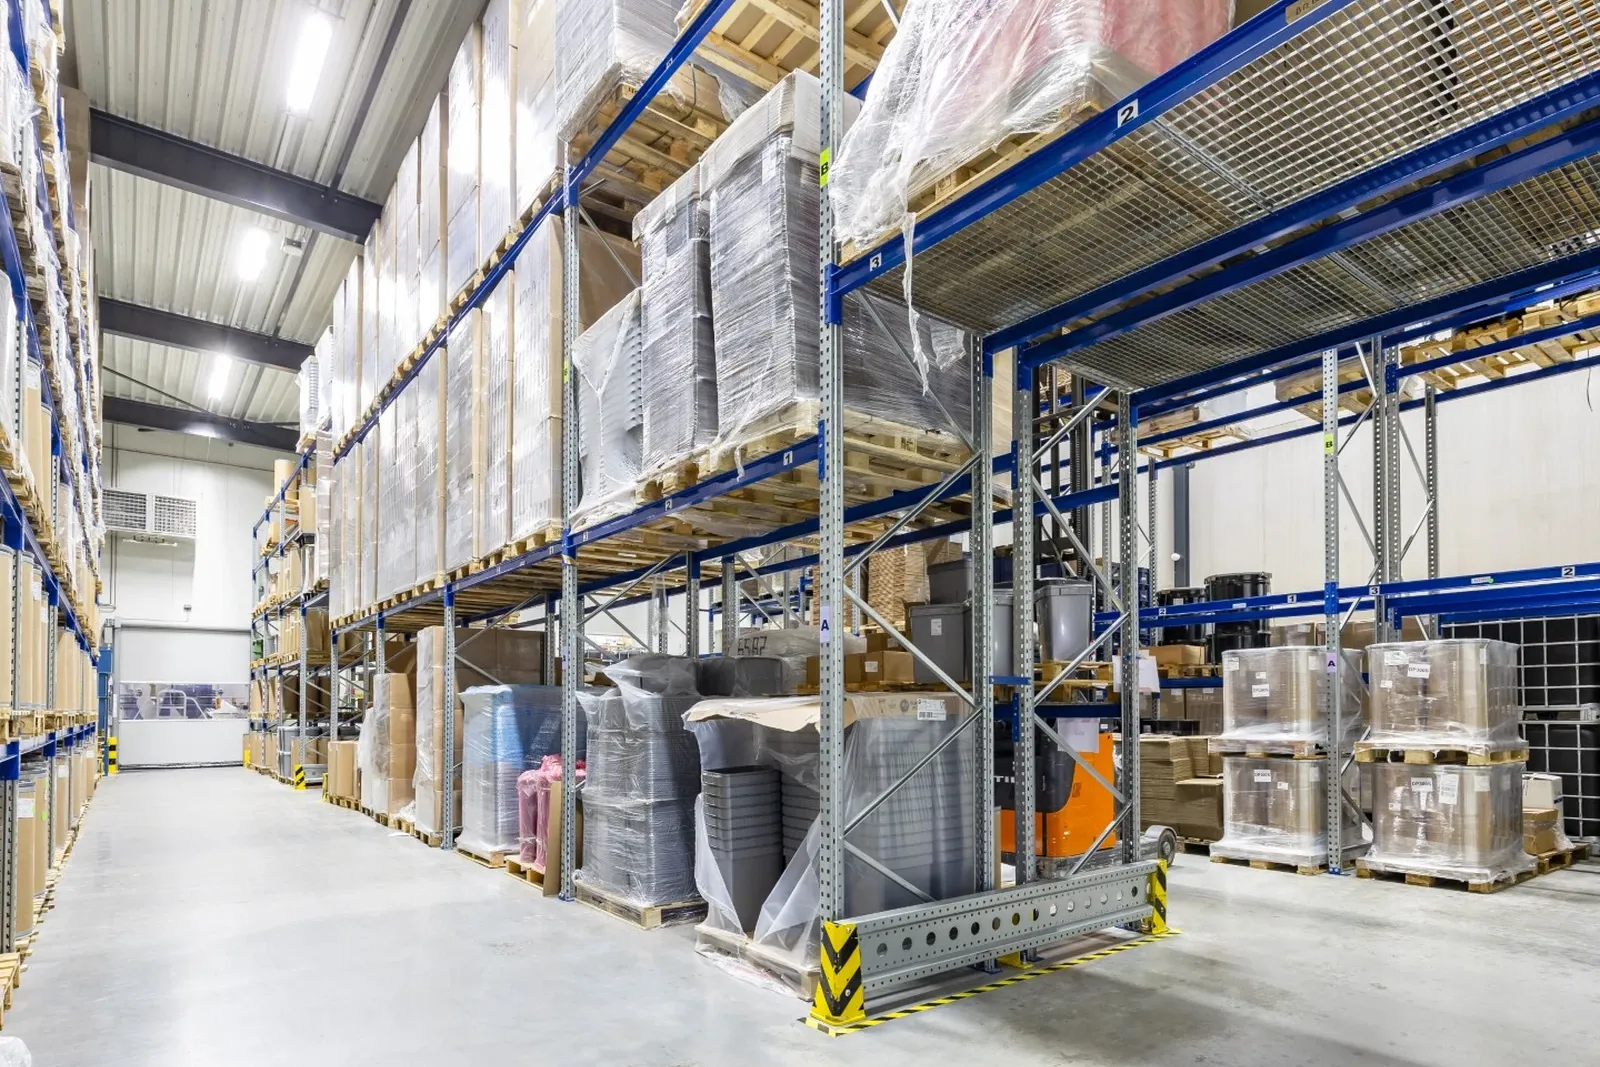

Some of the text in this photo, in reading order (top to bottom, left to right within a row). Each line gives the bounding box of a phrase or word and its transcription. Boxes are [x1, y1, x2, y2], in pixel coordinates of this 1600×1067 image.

[1120, 105, 1134, 126] 2
[820, 161, 829, 177] B
[871, 256, 880, 270] 3
[1325, 440, 1333, 449] B
[1563, 567, 1573, 576] 2
[1371, 586, 1379, 595] 3
[820, 619, 830, 632] A
